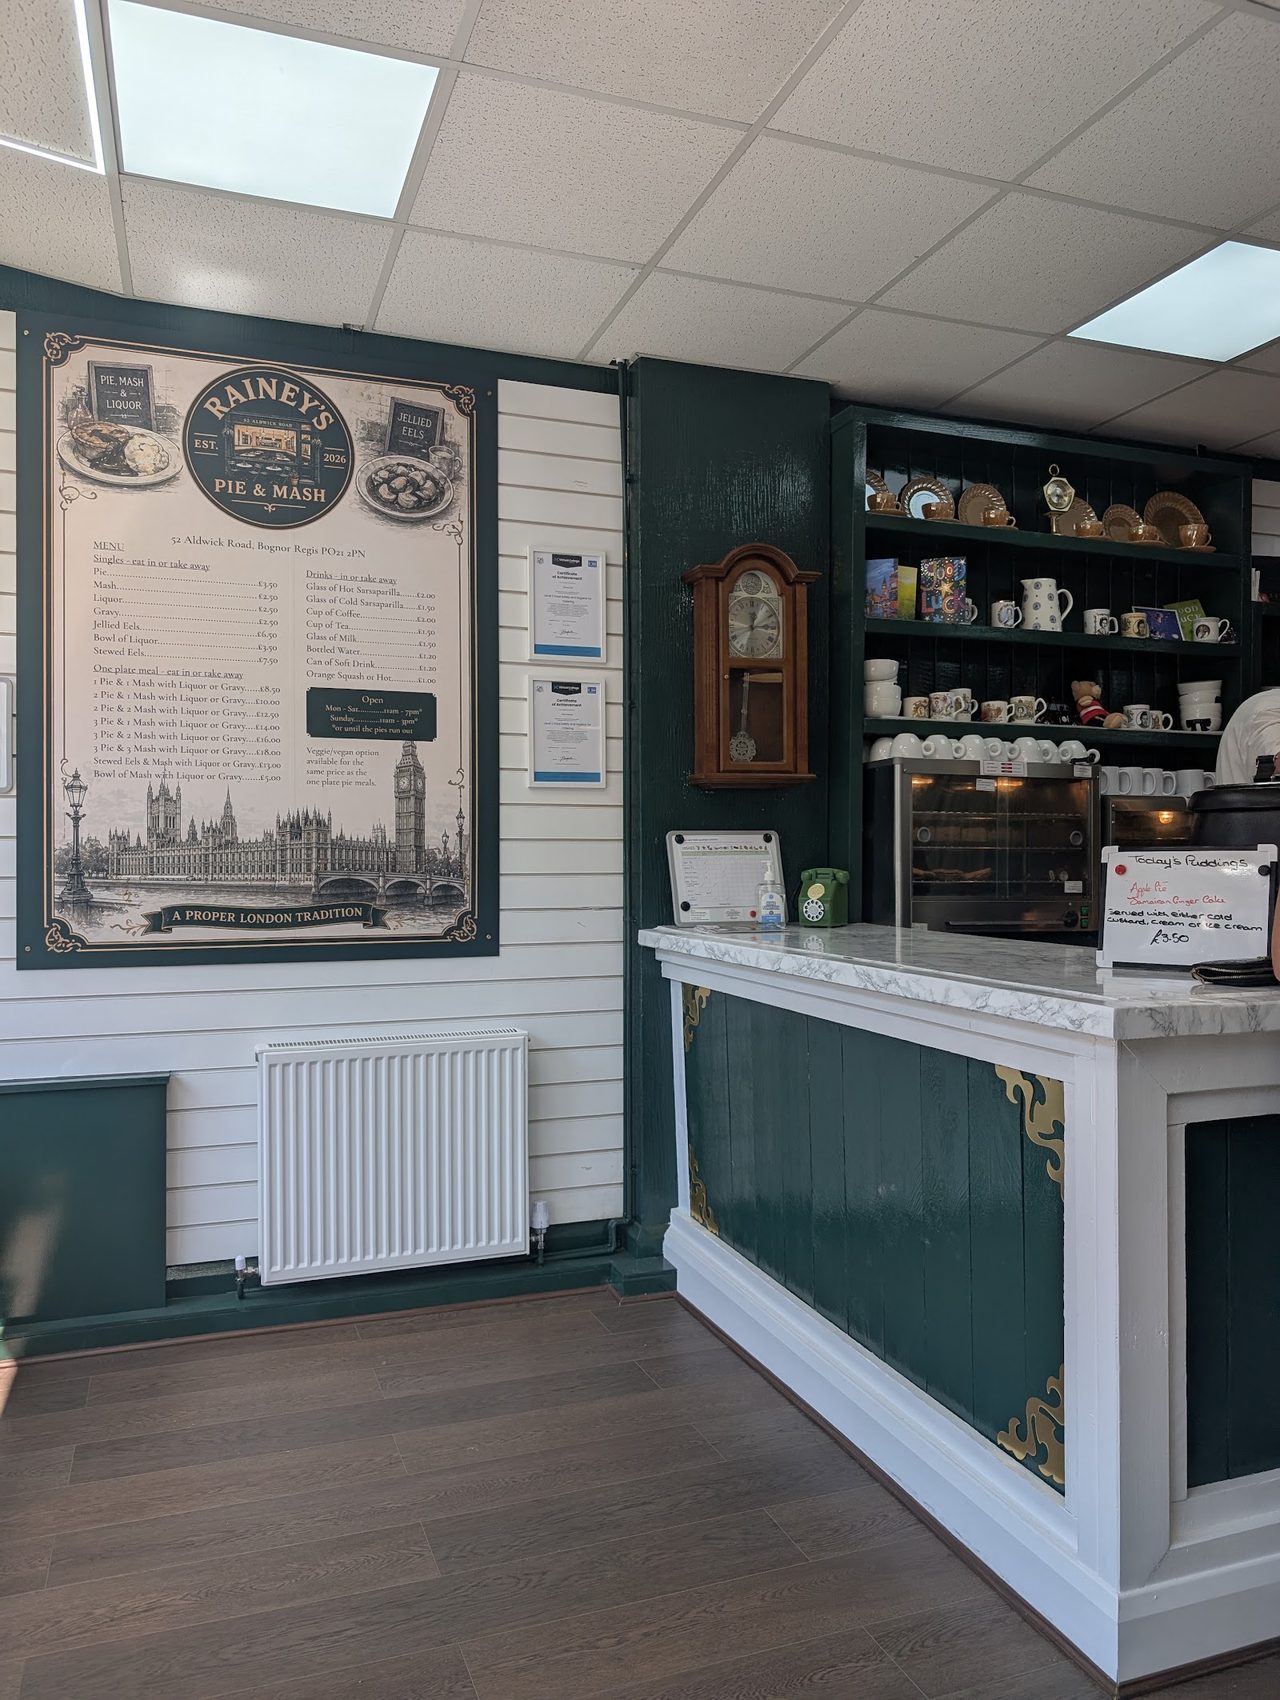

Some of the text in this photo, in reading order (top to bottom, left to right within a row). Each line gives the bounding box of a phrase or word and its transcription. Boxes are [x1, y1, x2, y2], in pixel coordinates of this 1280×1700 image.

[100, 375, 143, 387] PIE, MASH
[107, 400, 142, 410] LIQUOR
[204, 378, 334, 431] RAINEY'S
[397, 413, 432, 427] JELLIED
[402, 427, 424, 439] EELS
[195, 440, 218, 450] EST.
[324, 454, 346, 463] 2026
[215, 479, 325, 502] PIE & MASH
[94, 541, 124, 551] MENU
[184, 536, 223, 547] Aldwick
[228, 540, 254, 550] Road,
[258, 541, 291, 553] Bognor
[294, 545, 318, 556] Regis
[322, 547, 344, 556] PO21
[94, 554, 124, 565] Singles
[171, 560, 188, 569] take
[190, 564, 210, 572] away
[306, 570, 332, 579] Drinks
[361, 574, 376, 583] take
[306, 583, 326, 591] Glass
[306, 608, 323, 617] Cup
[93, 621, 120, 630] Jellied
[94, 647, 124, 656] Stewed
[306, 646, 335, 654] Bottled
[94, 664, 113, 673] One
[115, 665, 136, 675] plate
[139, 666, 158, 675] meal
[204, 669, 221, 678] take
[306, 670, 335, 679] Orange
[338, 672, 364, 681] Squash
[132, 679, 155, 687] Mash
[157, 680, 176, 689] with
[180, 681, 207, 691] Liquor
[362, 696, 383, 704] Open
[134, 745, 156, 753] Mash
[159, 746, 178, 754] with
[181, 747, 208, 757] Liquor
[307, 747, 353, 756] Veggie/vegan
[94, 757, 122, 766] Stewed
[153, 758, 173, 766] Mash
[175, 759, 192, 768] with
[195, 760, 220, 770] Liquor
[327, 768, 344, 777] price
[1128, 855, 1248, 869] Today's Puddings
[1130, 882, 1152, 896] Apple
[1173, 896, 1199, 906] Ginger
[173, 907, 362, 923] A PROPER LONDON TRADITION
[1171, 910, 1204, 919] either
